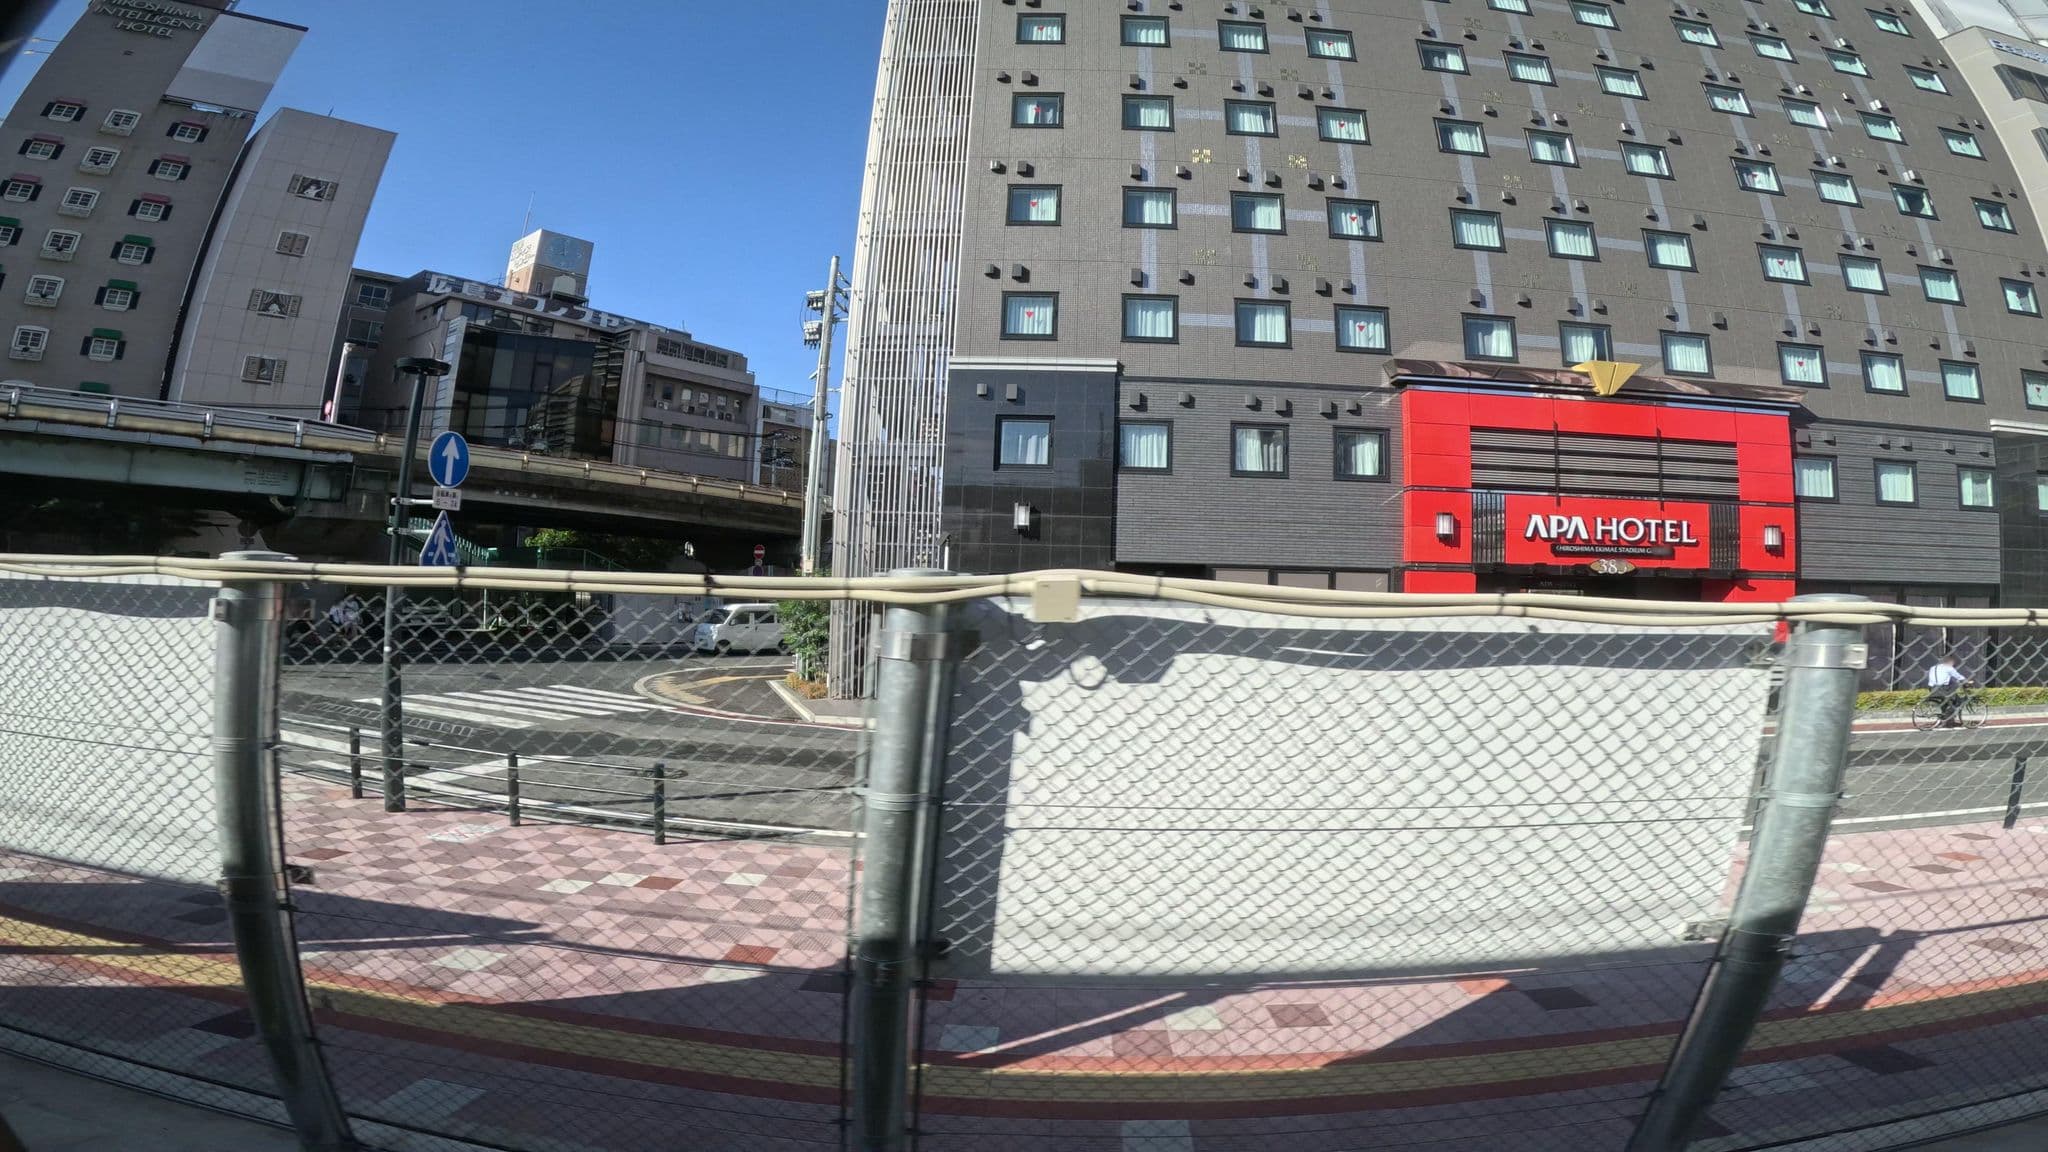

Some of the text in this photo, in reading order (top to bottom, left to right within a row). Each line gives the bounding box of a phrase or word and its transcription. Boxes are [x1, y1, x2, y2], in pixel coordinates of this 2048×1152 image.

[95, 6, 204, 30] INTELLIGENT
[116, 20, 174, 37] HOTEL
[1525, 514, 1697, 543] APA HOTEL
